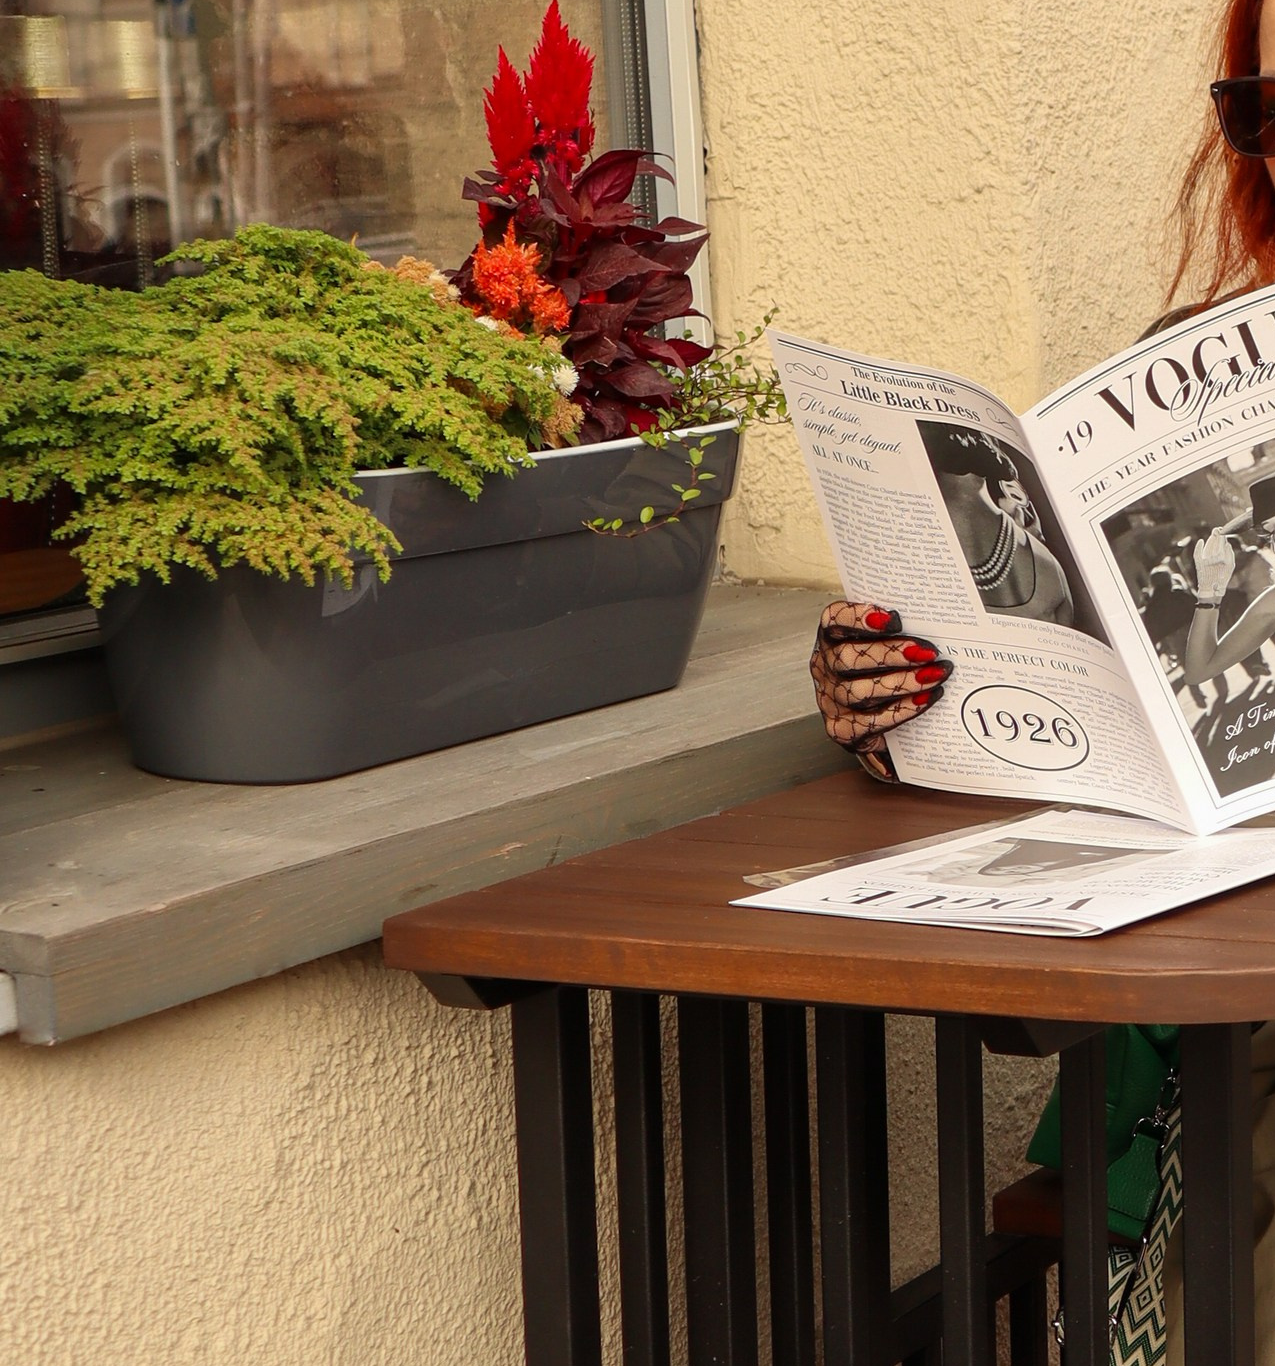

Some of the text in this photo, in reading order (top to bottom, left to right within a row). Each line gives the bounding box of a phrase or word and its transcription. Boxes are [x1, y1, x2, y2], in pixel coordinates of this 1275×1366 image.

[851, 366, 956, 397] The Evolution of the
[797, 392, 862, 427] It's classic,
[839, 380, 981, 422] Little Black Dress
[803, 419, 902, 455] simple, yet elegant,
[812, 443, 831, 461] ALL
[832, 449, 845, 465] AT
[1079, 477, 1113, 504] THE
[1114, 451, 1157, 481] YEAR
[1161, 413, 1235, 456] FASHION
[946, 645, 959, 656] IS
[964, 647, 989, 660] THE
[993, 650, 1045, 668] PERFECT
[1050, 659, 1089, 677] COLOR
[1037, 637, 1059, 646] COCO
[1061, 642, 1090, 655] CHANEL
[970, 708, 1079, 749] 1926
[1225, 713, 1244, 740] A
[1220, 745, 1260, 772] Icon
[822, 886, 1095, 912] VOGUE
